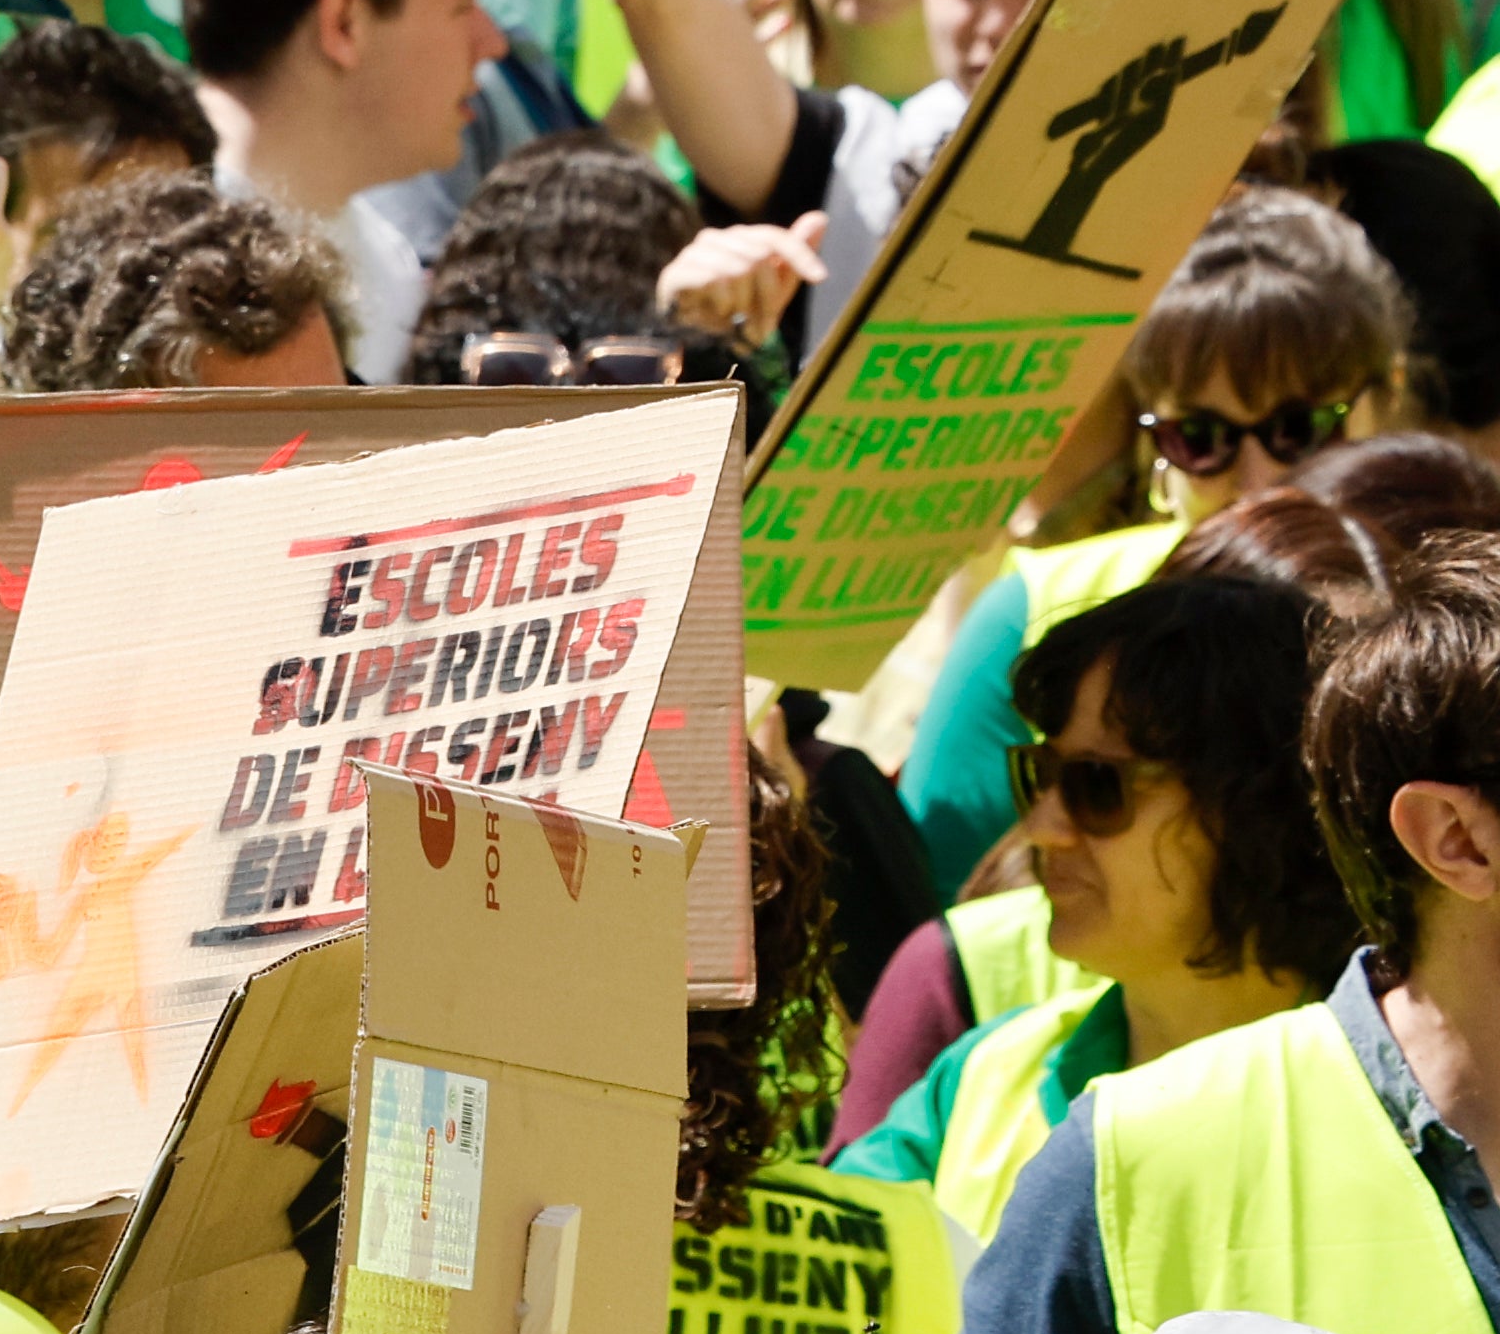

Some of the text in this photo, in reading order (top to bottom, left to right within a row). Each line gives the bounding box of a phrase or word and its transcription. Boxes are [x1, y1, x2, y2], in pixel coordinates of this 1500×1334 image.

[845, 336, 1086, 402] ESCOLES
[769, 405, 1077, 473] SUPERIORS
[743, 473, 1046, 543] DE DISSENY
[318, 511, 627, 639] ESCOLES
[251, 597, 647, 738] SUPERIORS
[218, 744, 323, 834] DE
[223, 825, 329, 920] EN
[673, 1236, 894, 1318] SSENY
